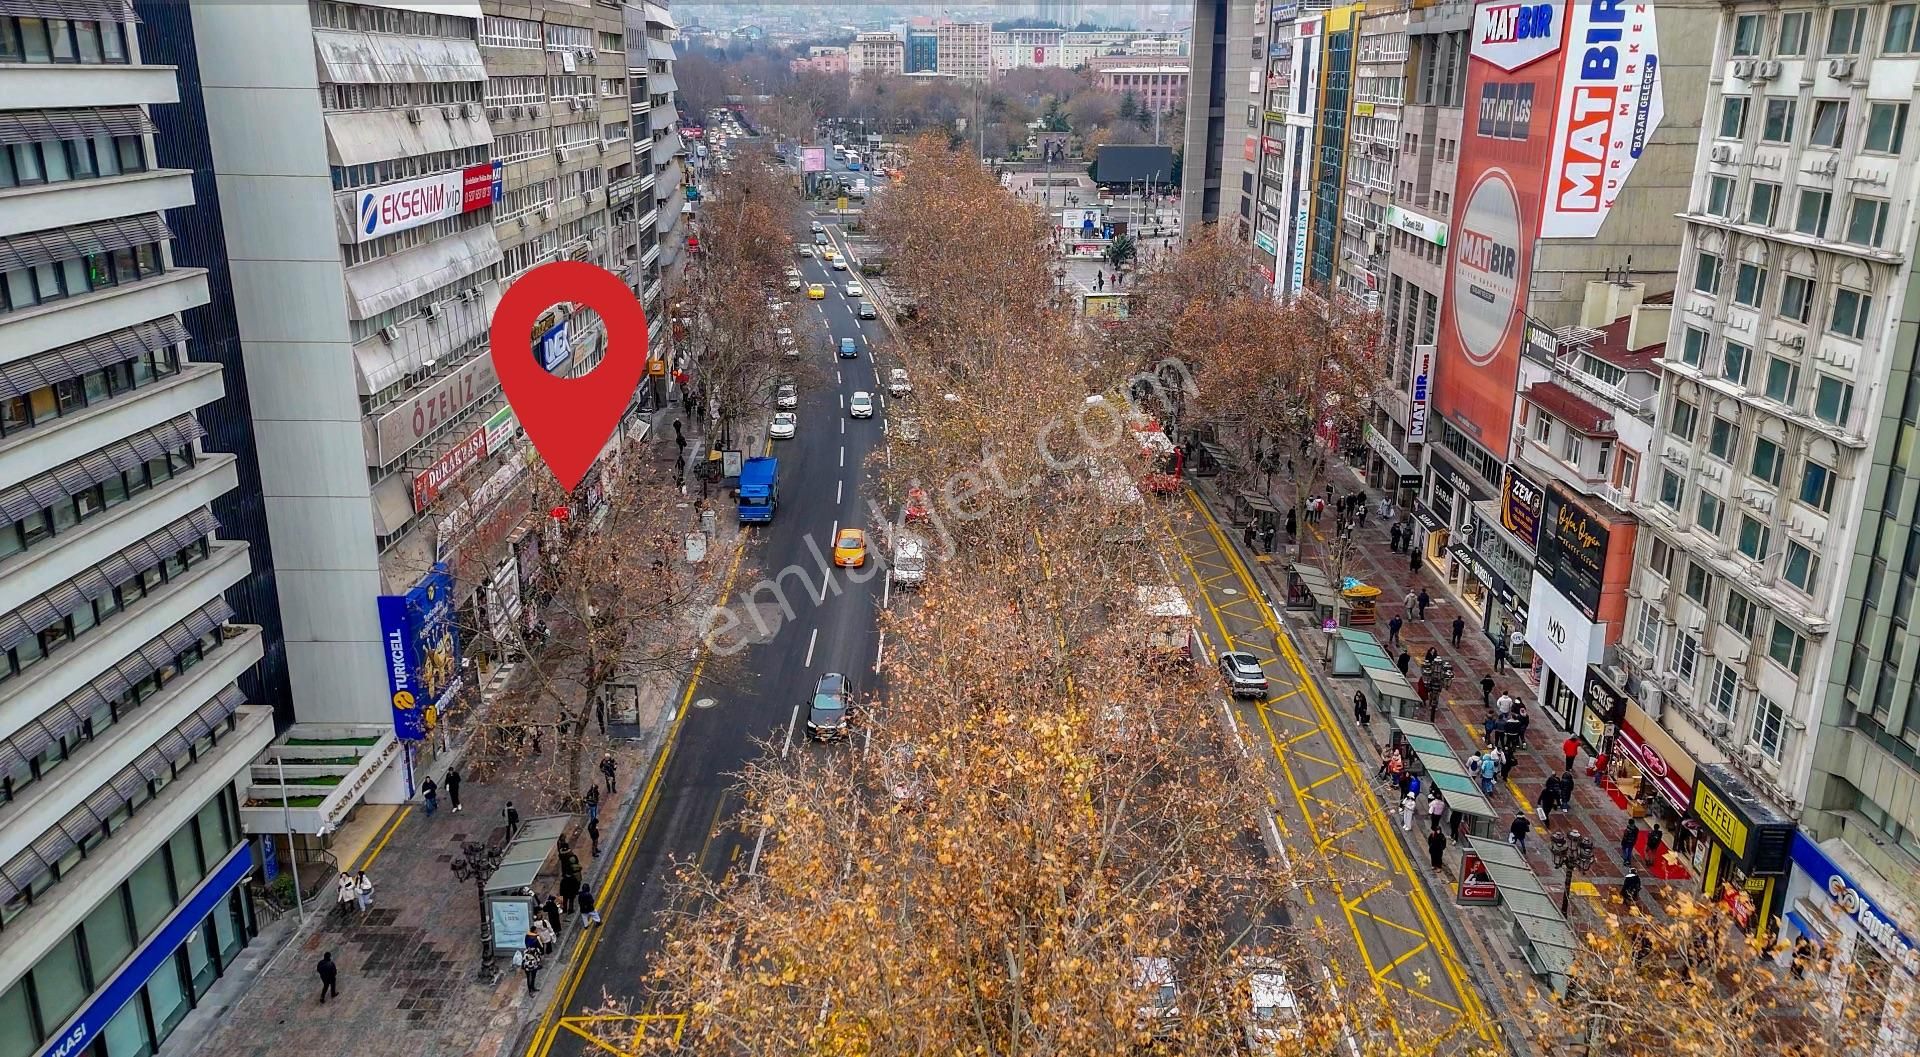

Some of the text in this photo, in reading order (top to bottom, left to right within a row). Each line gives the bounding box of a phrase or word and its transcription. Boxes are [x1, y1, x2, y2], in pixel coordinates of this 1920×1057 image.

[1484, 3, 1553, 42] MATBIR
[1481, 97, 1531, 123] TYT AYT LGS
[1604, 140, 1624, 208] KURS
[446, 184, 460, 212] vip
[1460, 229, 1516, 280] MATBIR
[412, 372, 474, 438] ÖZELİZ
[1411, 374, 1428, 436] MATBIR
[1450, 472, 1470, 496] SARAR
[1512, 479, 1534, 505] ZEM
[389, 628, 409, 691] TURKCELL
[1703, 793, 1732, 837] EYFEL
